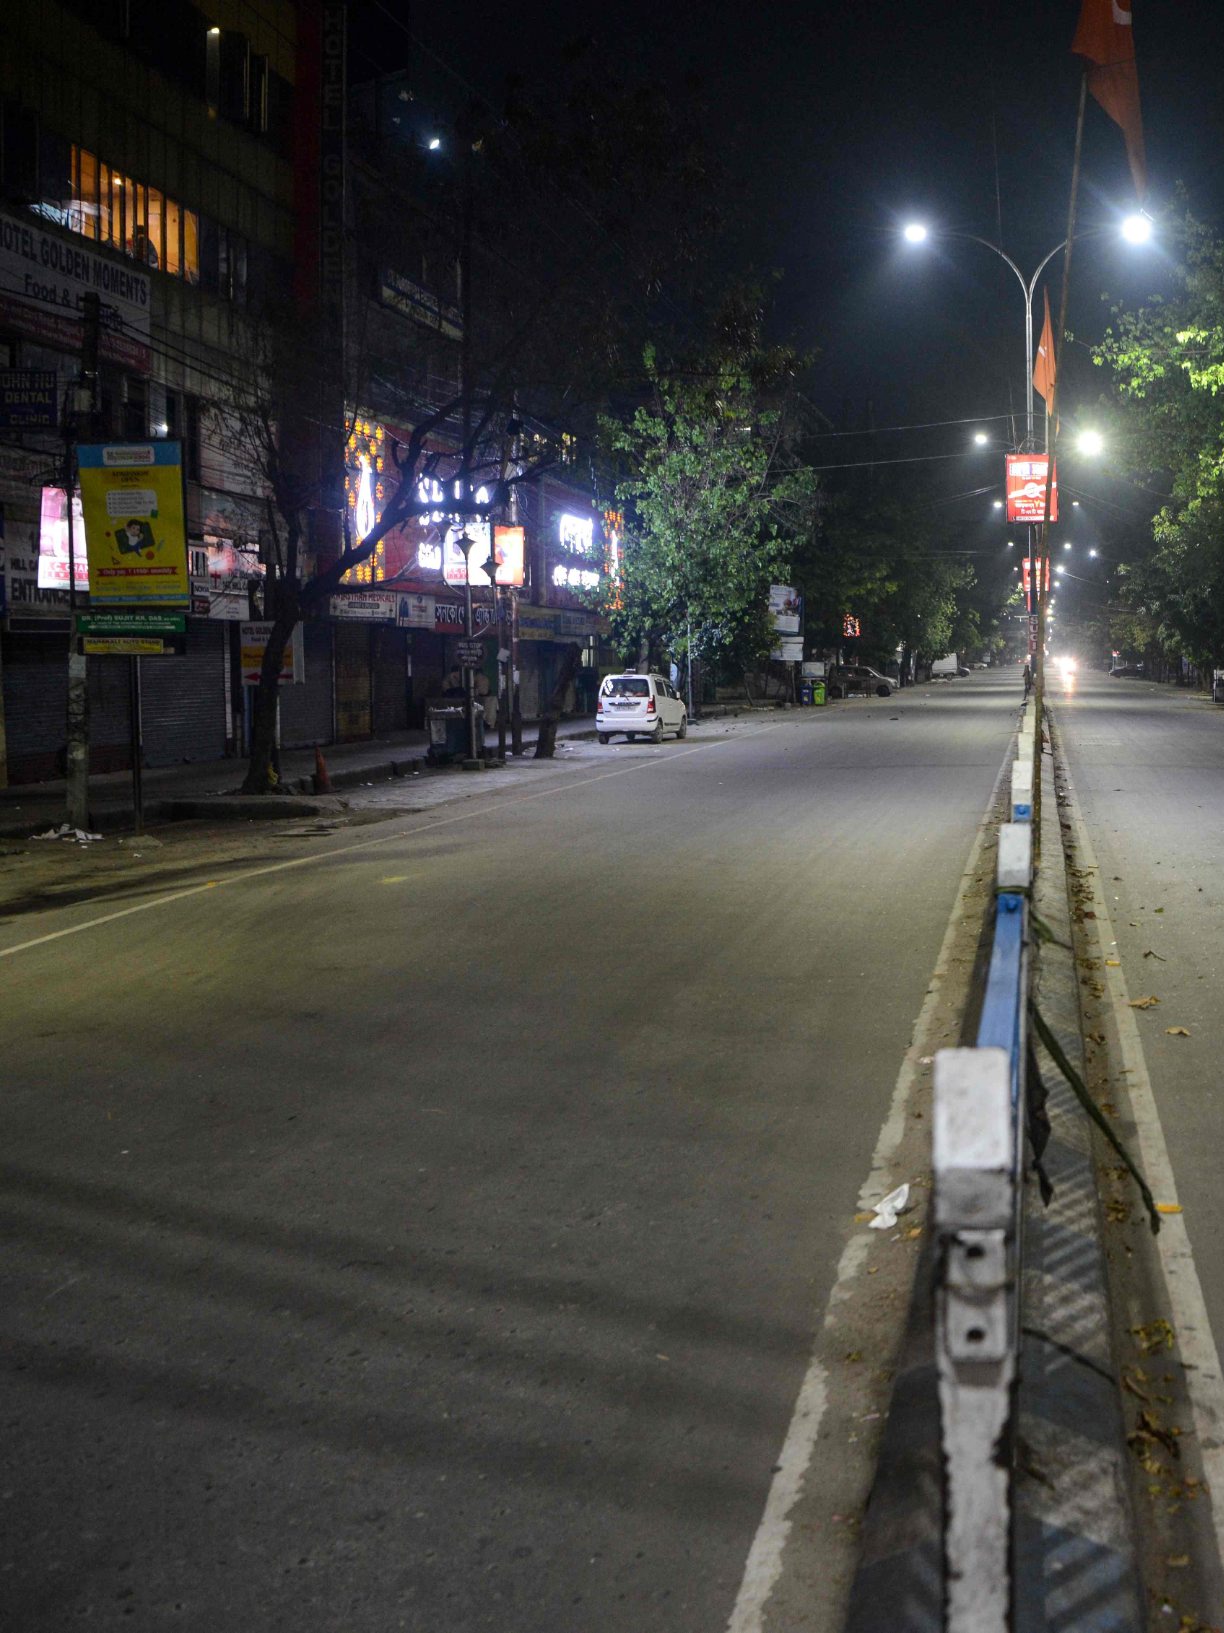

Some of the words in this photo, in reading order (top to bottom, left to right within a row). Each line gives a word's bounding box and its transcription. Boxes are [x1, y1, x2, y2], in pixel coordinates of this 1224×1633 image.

[41, 237, 90, 283] GOLDEN
[93, 259, 147, 306] MOMENTS
[25, 272, 57, 302] Food
[5, 391, 52, 404] DENTAL
